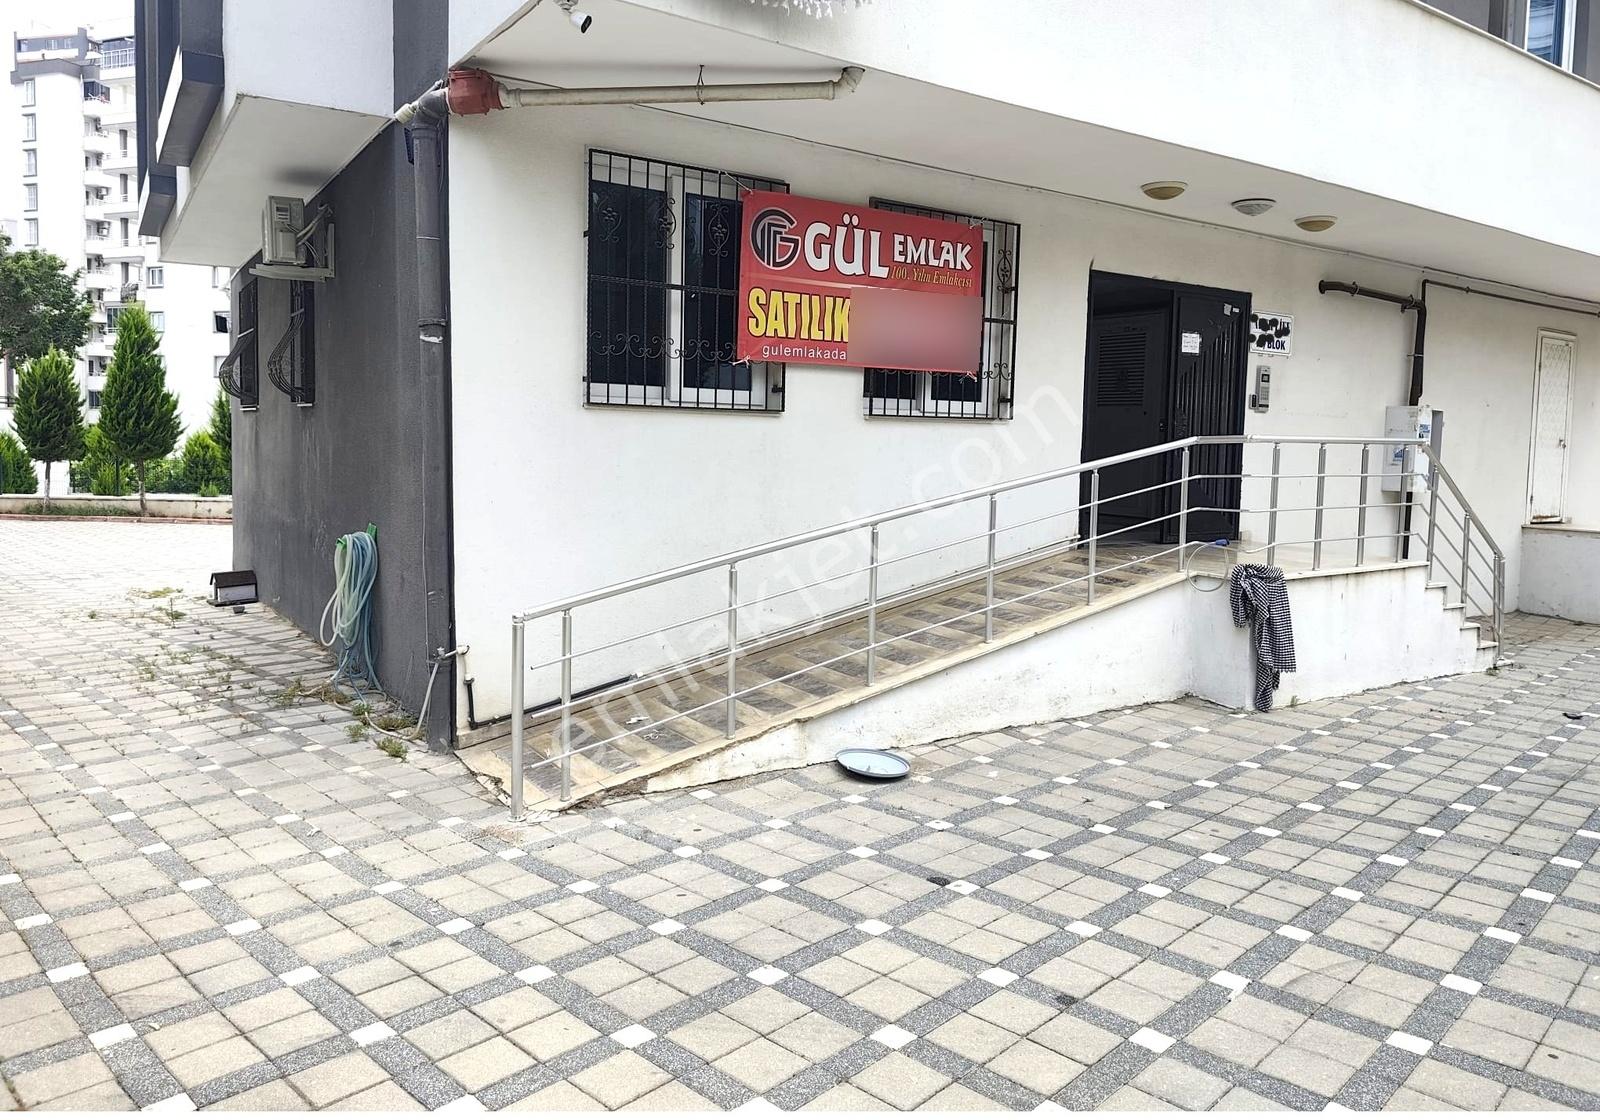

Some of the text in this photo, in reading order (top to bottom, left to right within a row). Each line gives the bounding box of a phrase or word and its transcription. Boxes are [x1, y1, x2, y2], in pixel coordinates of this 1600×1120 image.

[804, 212, 973, 279] GÜL EMLAK
[891, 265, 910, 280] 100.
[748, 287, 850, 342] SATILIK
